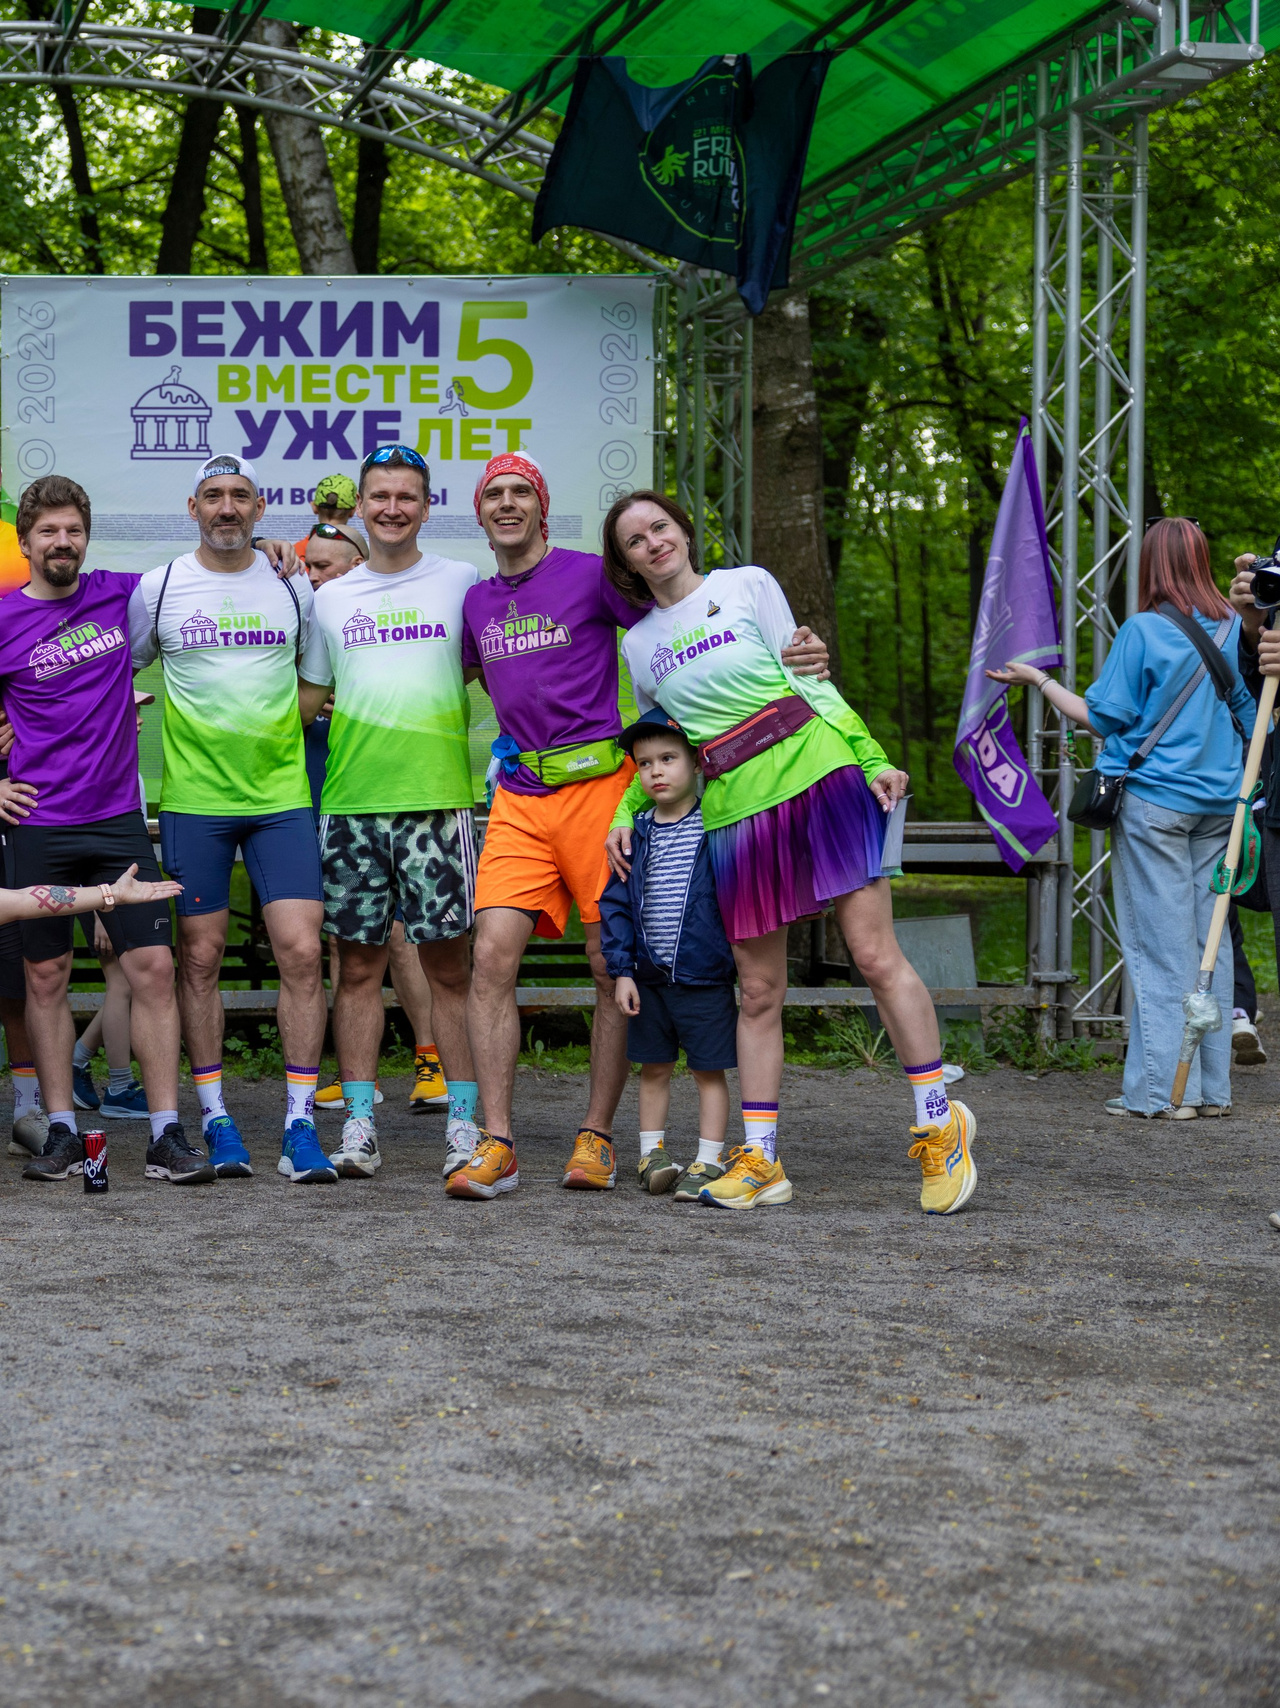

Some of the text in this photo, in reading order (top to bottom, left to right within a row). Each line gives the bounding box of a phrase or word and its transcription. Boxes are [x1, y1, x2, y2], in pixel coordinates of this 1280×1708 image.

[128, 300, 440, 358] БЕЖИМ
[16, 300, 56, 425] 2026
[451, 300, 534, 411] 5
[598, 301, 639, 426] 2026
[217, 364, 441, 404] ВМЕСТЕ
[234, 409, 402, 461] УЖЕ
[417, 418, 533, 461] ЛЕТ
[218, 615, 262, 631] RUN
[377, 610, 418, 628] RUN
[377, 623, 446, 643] TONDA
[504, 616, 539, 638] RUN
[58, 624, 99, 651] RUN
[67, 627, 125, 664] TONDA
[219, 629, 287, 646] TONDA
[504, 628, 567, 654] TONDA
[672, 626, 708, 652] RUN
[674, 630, 738, 666] TONDA
